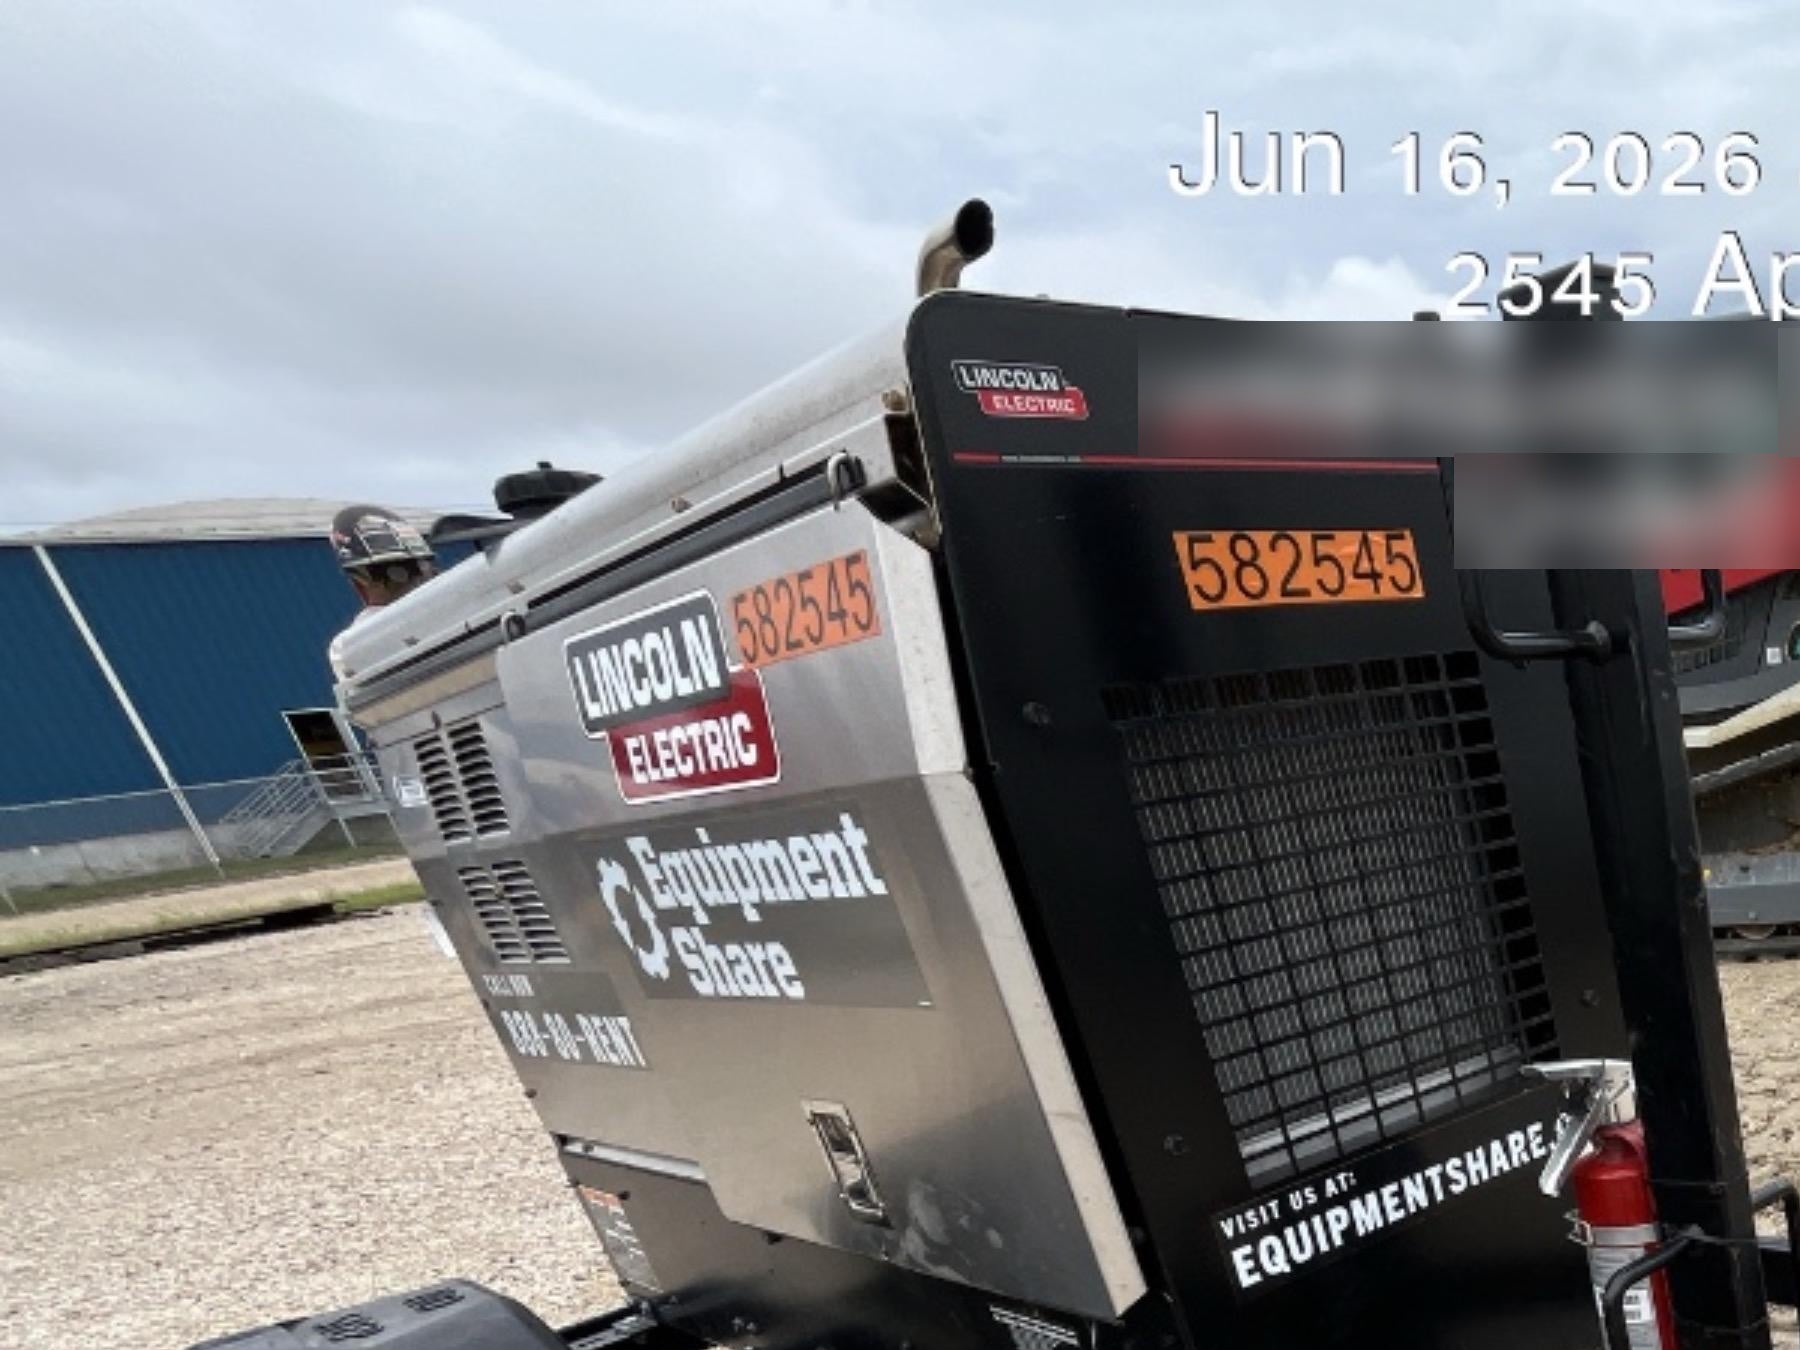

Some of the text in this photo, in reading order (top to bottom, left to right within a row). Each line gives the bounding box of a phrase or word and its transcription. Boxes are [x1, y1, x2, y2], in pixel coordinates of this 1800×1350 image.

[959, 365, 1060, 391] LINCOLN
[992, 395, 1076, 413] ELECTRIC
[1185, 532, 1418, 602] 582545
[731, 552, 876, 665] 582545
[569, 613, 722, 718] LINCOLN
[625, 712, 759, 785] ELECTRIC
[626, 813, 888, 923] Equipment
[671, 928, 805, 999] Share
[1219, 1171, 1356, 1239] VISIT US AT:
